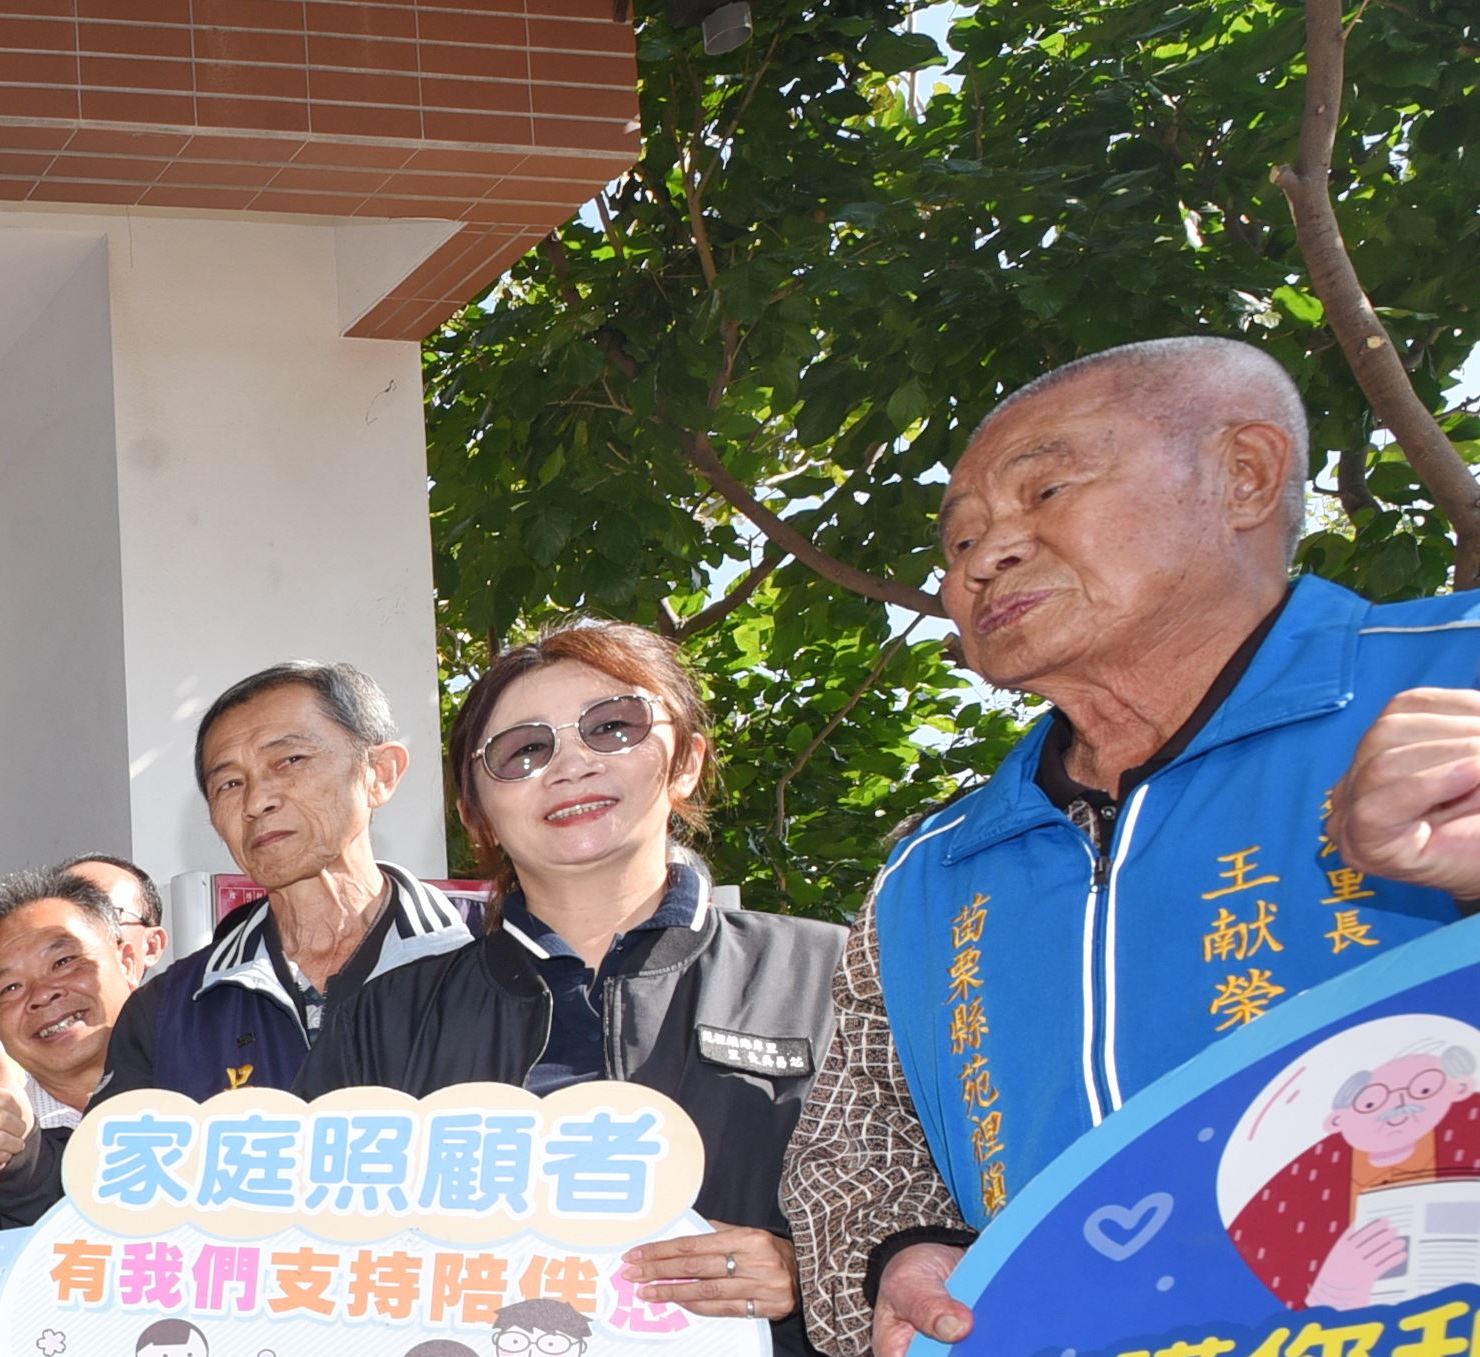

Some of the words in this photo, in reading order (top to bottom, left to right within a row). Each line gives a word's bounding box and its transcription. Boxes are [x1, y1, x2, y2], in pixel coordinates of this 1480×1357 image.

[94, 1110, 664, 1218] 家庭照顧者
[49, 1238, 693, 1336] 有我們支持陪伴您
